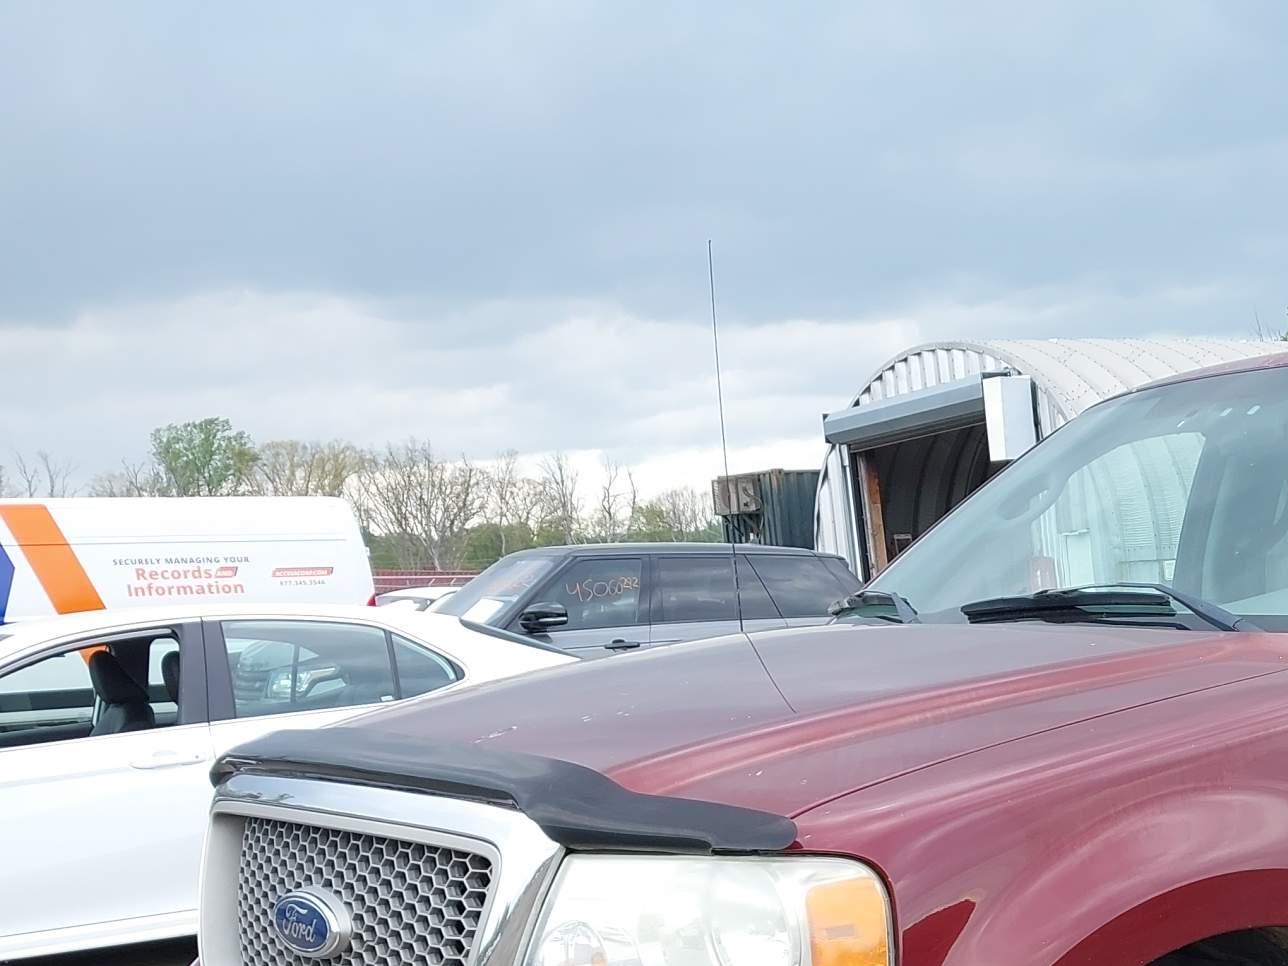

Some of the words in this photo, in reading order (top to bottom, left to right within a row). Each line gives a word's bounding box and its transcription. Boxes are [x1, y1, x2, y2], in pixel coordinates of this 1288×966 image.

[112, 558, 161, 566] SECURELY
[165, 556, 220, 565] MANAGING
[135, 566, 212, 581] Records
[127, 581, 245, 597] Information
[283, 904, 316, 942] Ford
